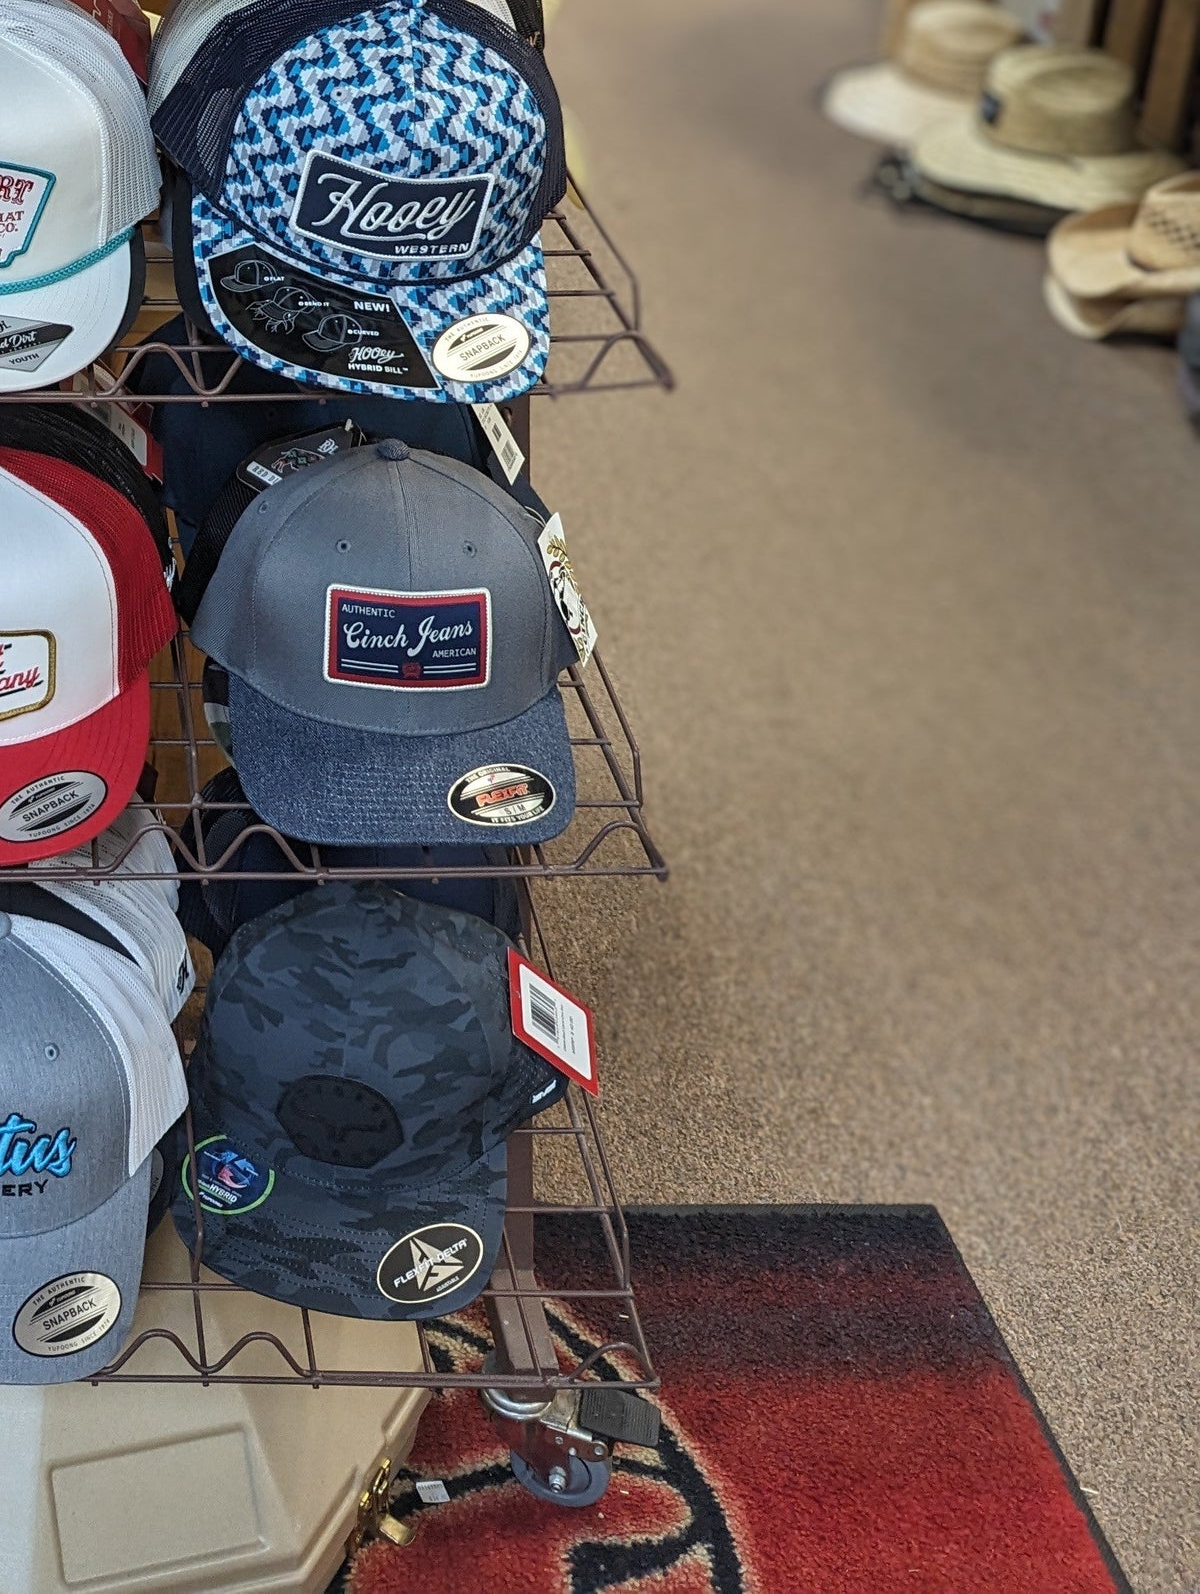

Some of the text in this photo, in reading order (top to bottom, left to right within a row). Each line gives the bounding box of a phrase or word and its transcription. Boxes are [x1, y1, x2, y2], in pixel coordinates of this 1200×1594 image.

[312, 172, 477, 241] Hooey
[394, 242, 470, 255] WESTERN
[354, 300, 391, 313] NEW!
[8, 331, 37, 347] Dirt
[459, 333, 506, 361] SNAPBACK
[8, 353, 40, 365] YOUTH
[348, 363, 383, 373] HYBRID
[341, 603, 396, 619] AUTHENTIC
[343, 615, 473, 657] Cinch Jeans
[432, 647, 477, 658] AMERICAN
[465, 766, 511, 783] THE ORIGINAL
[11, 795, 23, 805] THE
[26, 775, 65, 795] AUTHENTIC
[475, 783, 529, 807] FLEXFIT
[22, 790, 80, 822] SNAPBACK
[63, 814, 82, 827] SINCE
[516, 811, 534, 822] YOUR
[209, 1184, 237, 1203] HYBRID
[393, 1257, 434, 1288] FLEXFIT
[33, 1294, 45, 1306] THE
[47, 1277, 86, 1295] AUTHENTIC
[42, 1297, 97, 1331] SNAPBACK
[80, 1332, 97, 1343] SINCE
